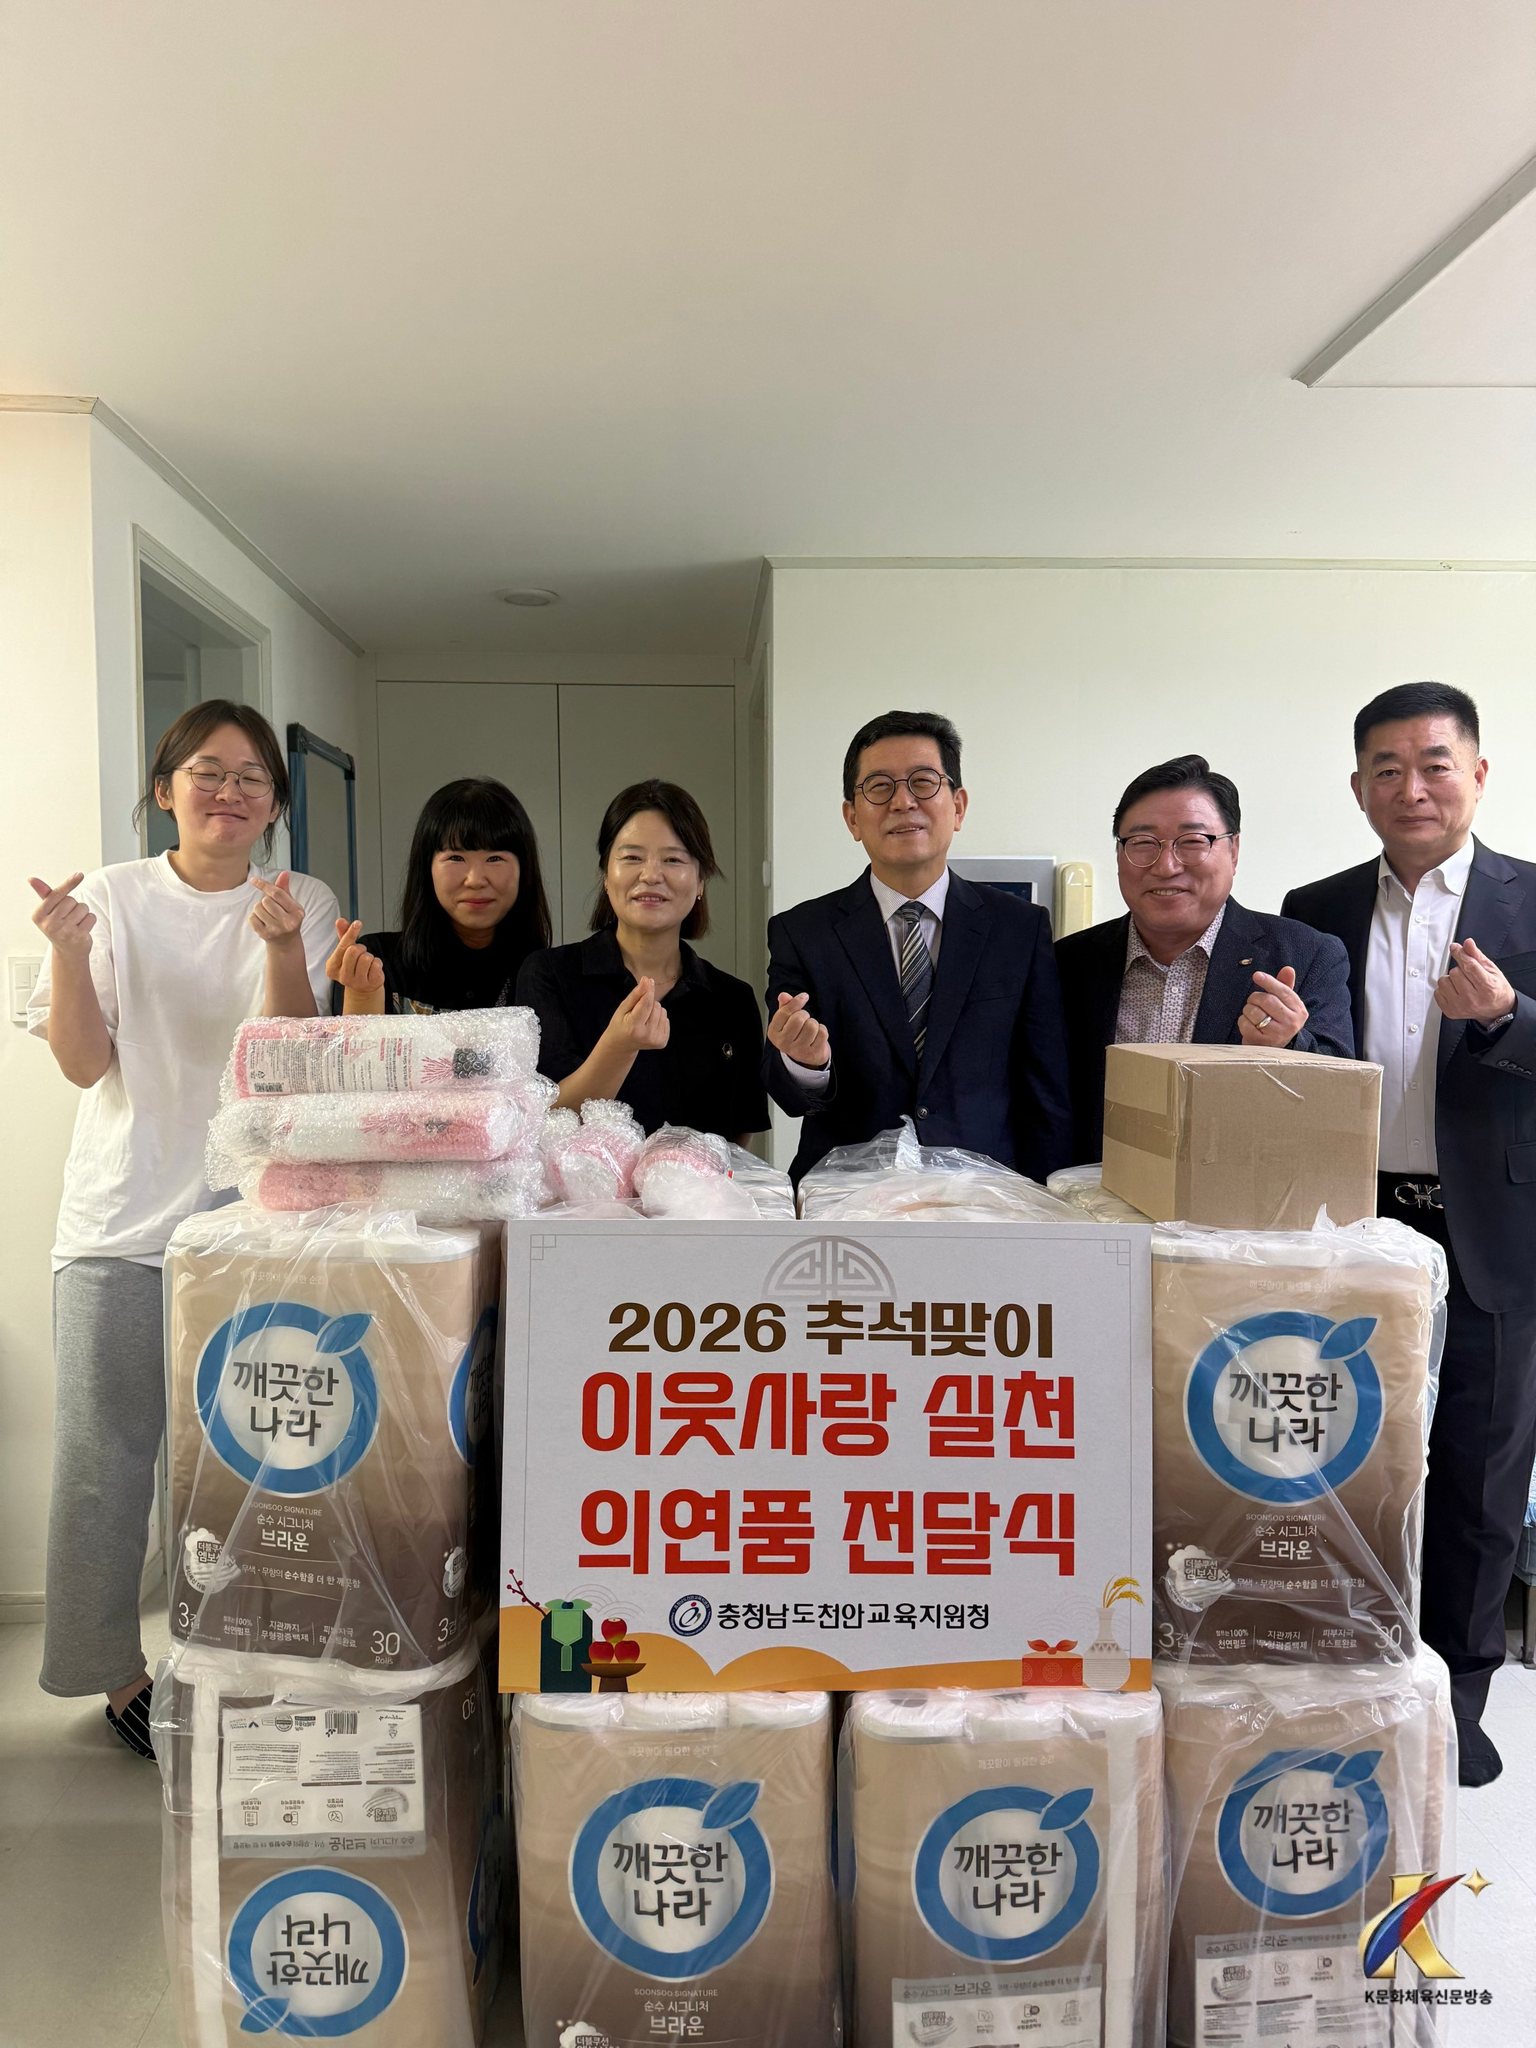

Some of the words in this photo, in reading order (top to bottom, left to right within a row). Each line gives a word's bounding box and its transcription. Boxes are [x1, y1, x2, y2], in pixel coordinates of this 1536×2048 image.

[608, 1302, 787, 1353] 2026
[806, 1300, 1053, 1358] 추석맞이
[233, 1361, 339, 1406] 깨끗한
[1230, 1373, 1343, 1413] 깨끗한
[250, 1406, 322, 1447] 나라
[581, 1371, 897, 1457] 이웃사랑
[922, 1371, 1075, 1459] 실천
[1249, 1416, 1325, 1453] 나라
[256, 1514, 275, 1525] 순수
[277, 1516, 314, 1531] 시그니처
[284, 1504, 323, 1517] SIGNATURE
[260, 1528, 309, 1553] 브라운
[578, 1488, 815, 1575] 의연품
[842, 1490, 1075, 1577] 전달식
[1255, 1526, 1275, 1537] 순수
[1278, 1525, 1317, 1537] 시그니처
[1259, 1540, 1312, 1560] 브라운
[284, 1570, 315, 1584] 순수함을
[1286, 1580, 1318, 1590] 순수함을
[716, 1602, 990, 1631] 충청남도천안교육지원청
[370, 1630, 400, 1656] 30
[1374, 1624, 1402, 1649] 30
[375, 1656, 394, 1665] Rolls
[1254, 1799, 1354, 1836] 깨끗한
[329, 1837, 367, 1851] 브라운
[1272, 1837, 1338, 1873] 나라
[612, 1841, 729, 1885] 깨끗한
[954, 1842, 1063, 1880] 깨끗한
[633, 1887, 712, 1928] 나라
[973, 1879, 1046, 1916] 나라
[281, 1912, 351, 1948] 나라
[266, 1950, 370, 1986] 깨끗한
[634, 1988, 674, 1997] SOONSOO
[674, 1988, 719, 1997] SIGNATURE
[953, 1981, 993, 1996] 브라운
[643, 2001, 665, 2012] 순수
[667, 2001, 709, 2013] 시그니처
[649, 2016, 705, 2037] 브라운
